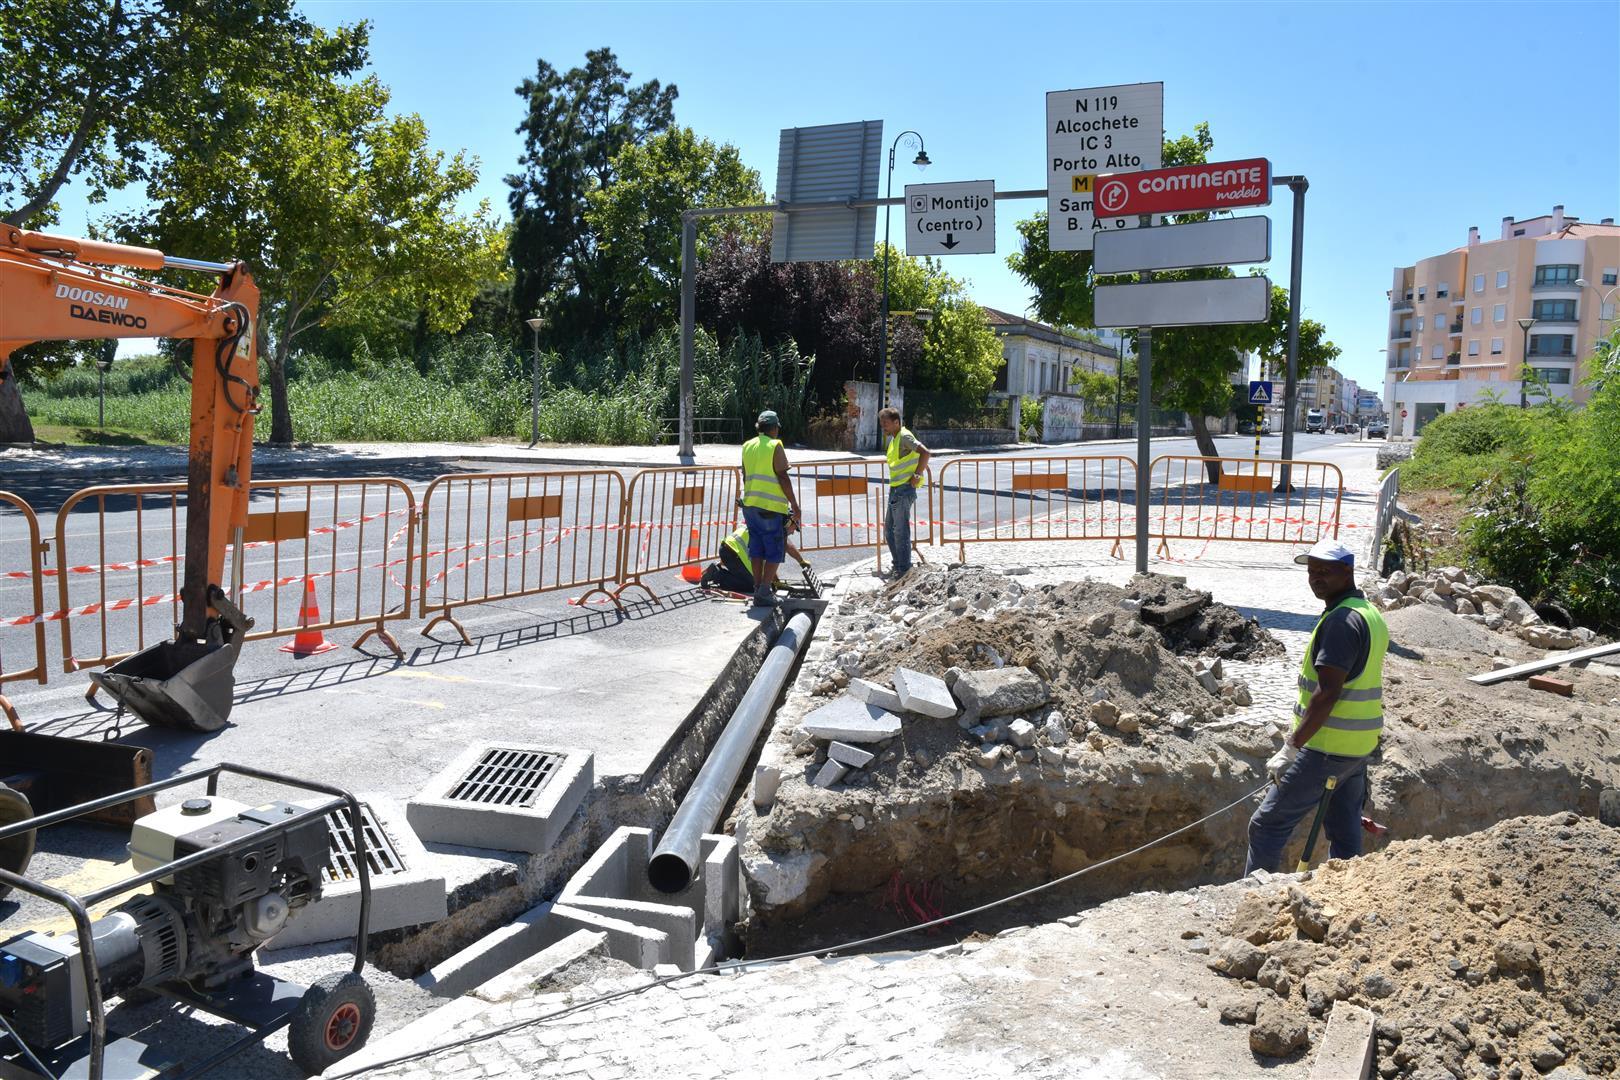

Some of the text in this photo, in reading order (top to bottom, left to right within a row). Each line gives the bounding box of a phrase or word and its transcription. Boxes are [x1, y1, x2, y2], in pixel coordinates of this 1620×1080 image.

[1076, 95, 1118, 113] N 119
[1055, 115, 1139, 134] Alcochete
[1080, 134, 1112, 150] IC 3
[1053, 153, 1141, 171] Porto Alto
[1074, 177, 1088, 191] M
[1138, 167, 1261, 194] CONTINENTE
[1216, 185, 1261, 201] modelo
[932, 195, 989, 211] Montijo
[1059, 198, 1094, 213] Sam
[917, 215, 982, 234] (centro)
[1067, 217, 1083, 231] B.
[1091, 218, 1107, 230] A.
[55, 284, 129, 310] DOOSAN
[70, 304, 147, 330] DAEWOO
